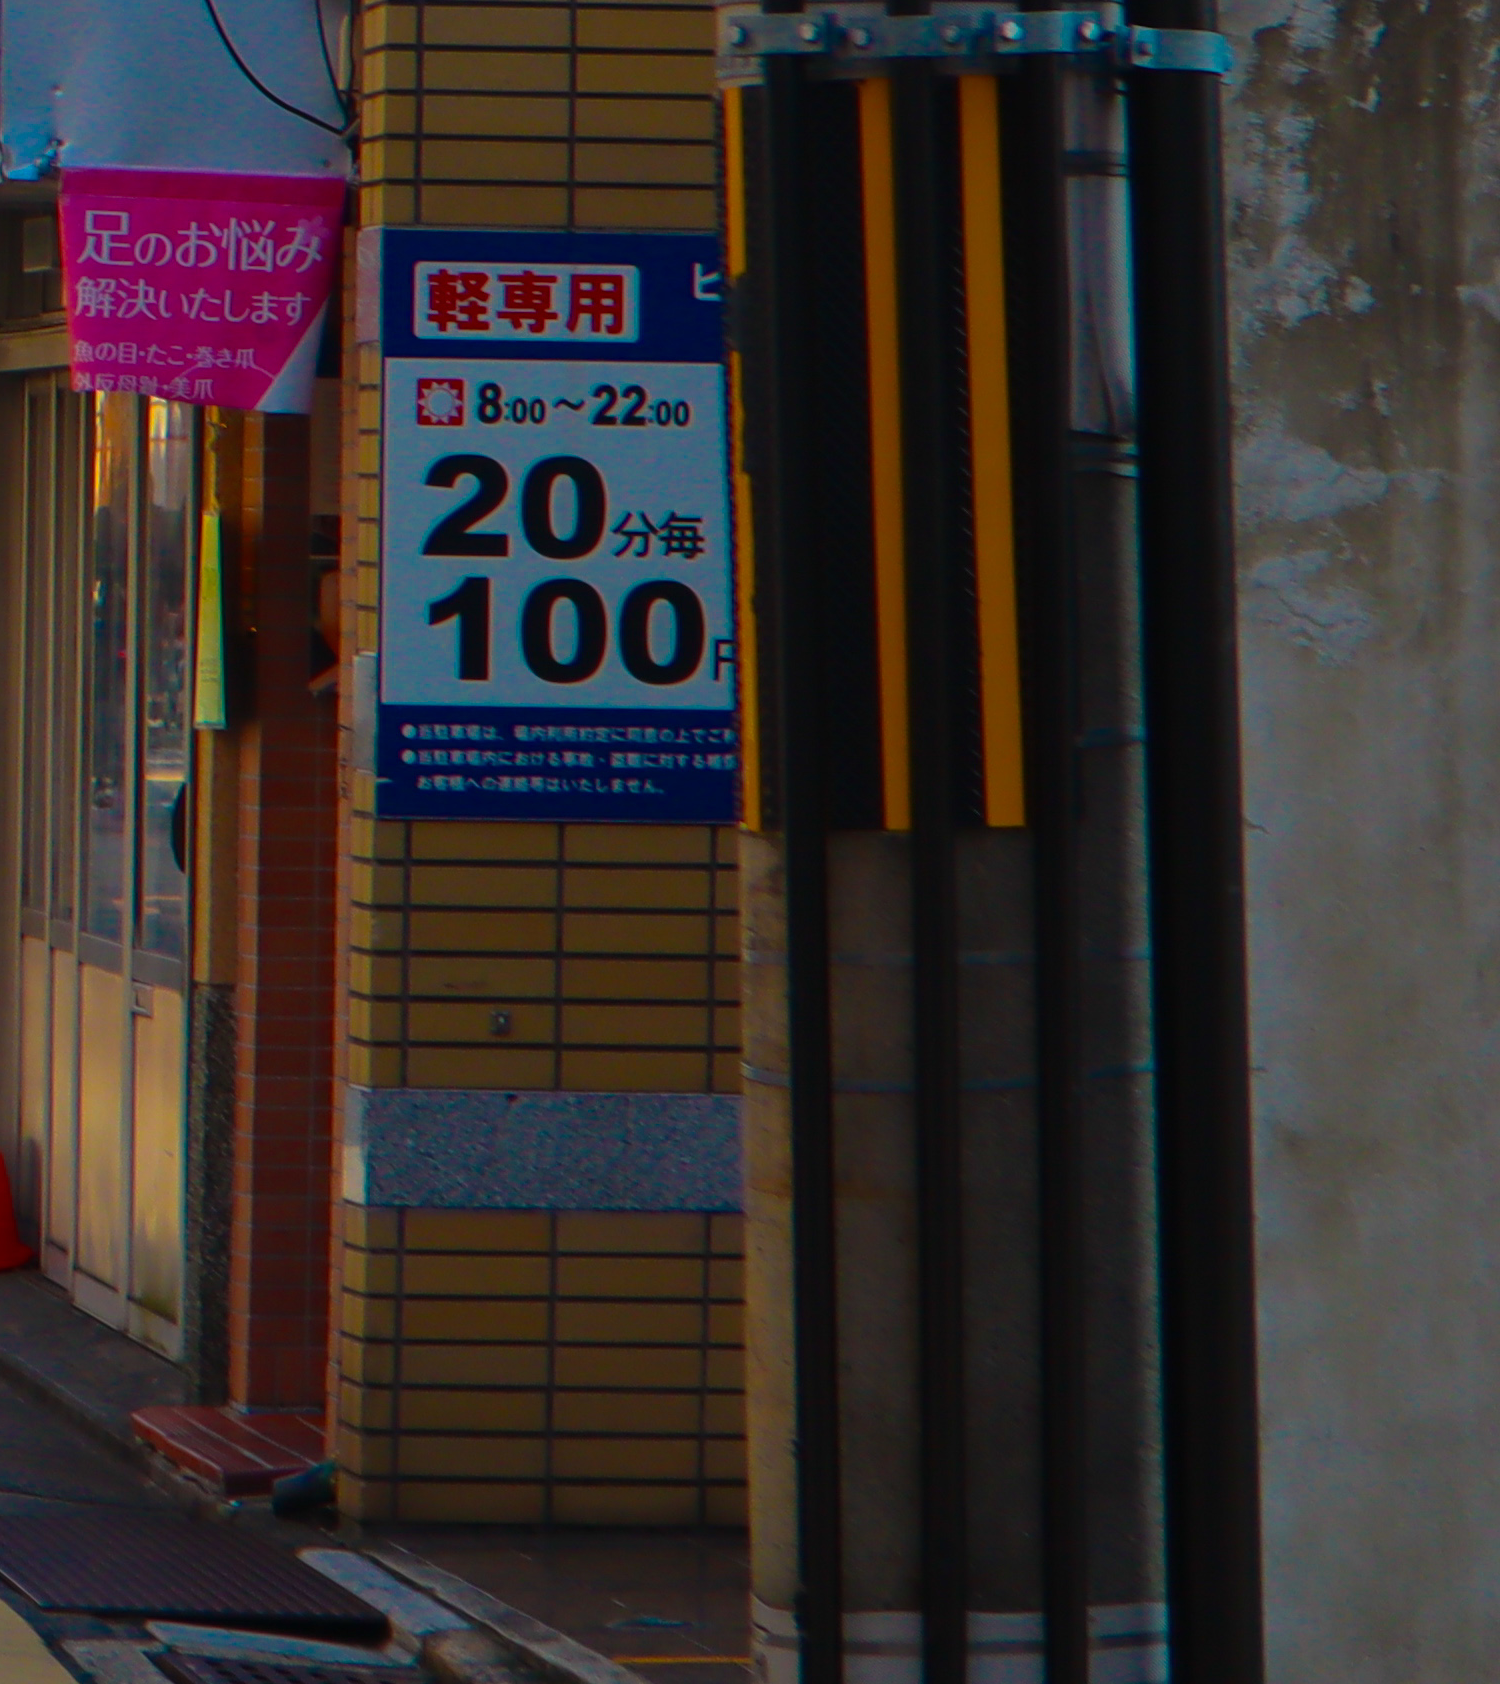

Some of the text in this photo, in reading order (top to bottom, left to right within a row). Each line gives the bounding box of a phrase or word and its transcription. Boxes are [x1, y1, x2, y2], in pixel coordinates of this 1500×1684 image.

[76, 209, 324, 273] 足のお悩み
[74, 275, 312, 327] 解決いたします
[426, 269, 626, 335] 軽専用
[74, 340, 257, 369] 魚の目・たこ・巻き爪
